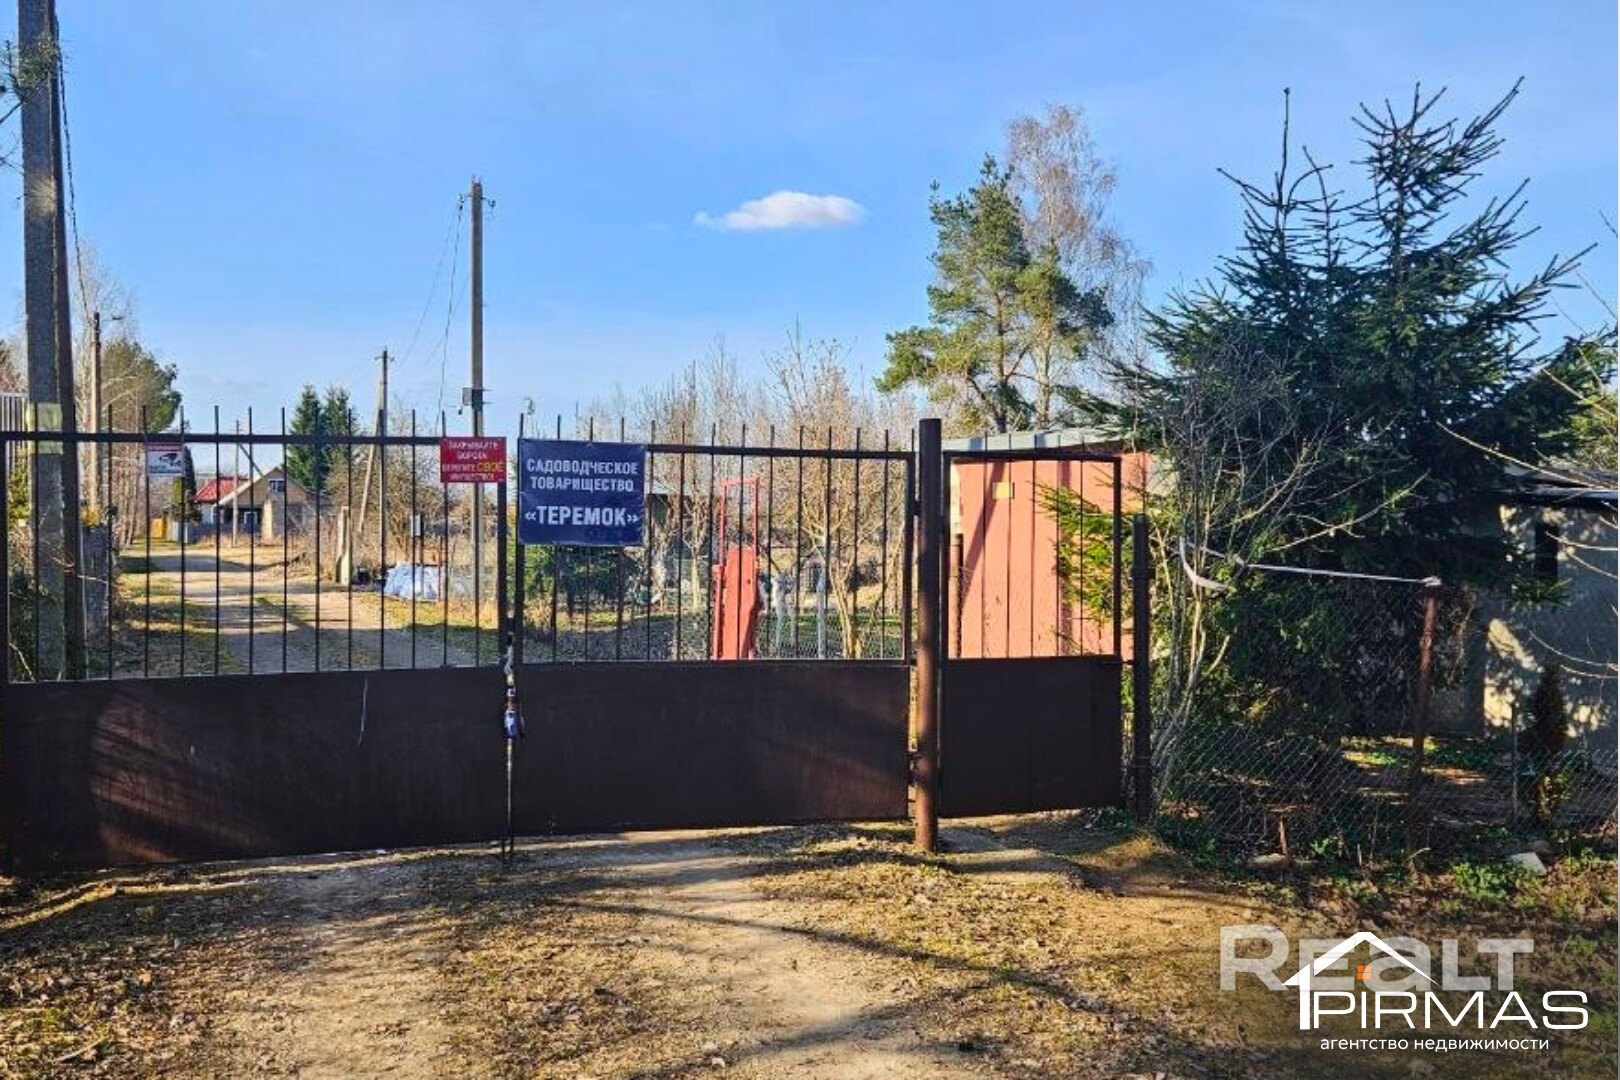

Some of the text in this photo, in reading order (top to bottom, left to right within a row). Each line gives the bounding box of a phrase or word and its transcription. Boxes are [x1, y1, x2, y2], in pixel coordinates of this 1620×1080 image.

[526, 458, 639, 476] САДОВОДЧЕСКОЕ
[530, 476, 634, 493] ТОВАРИЩЕСТВО
[524, 505, 639, 527] «ТЕРЕМОК»
